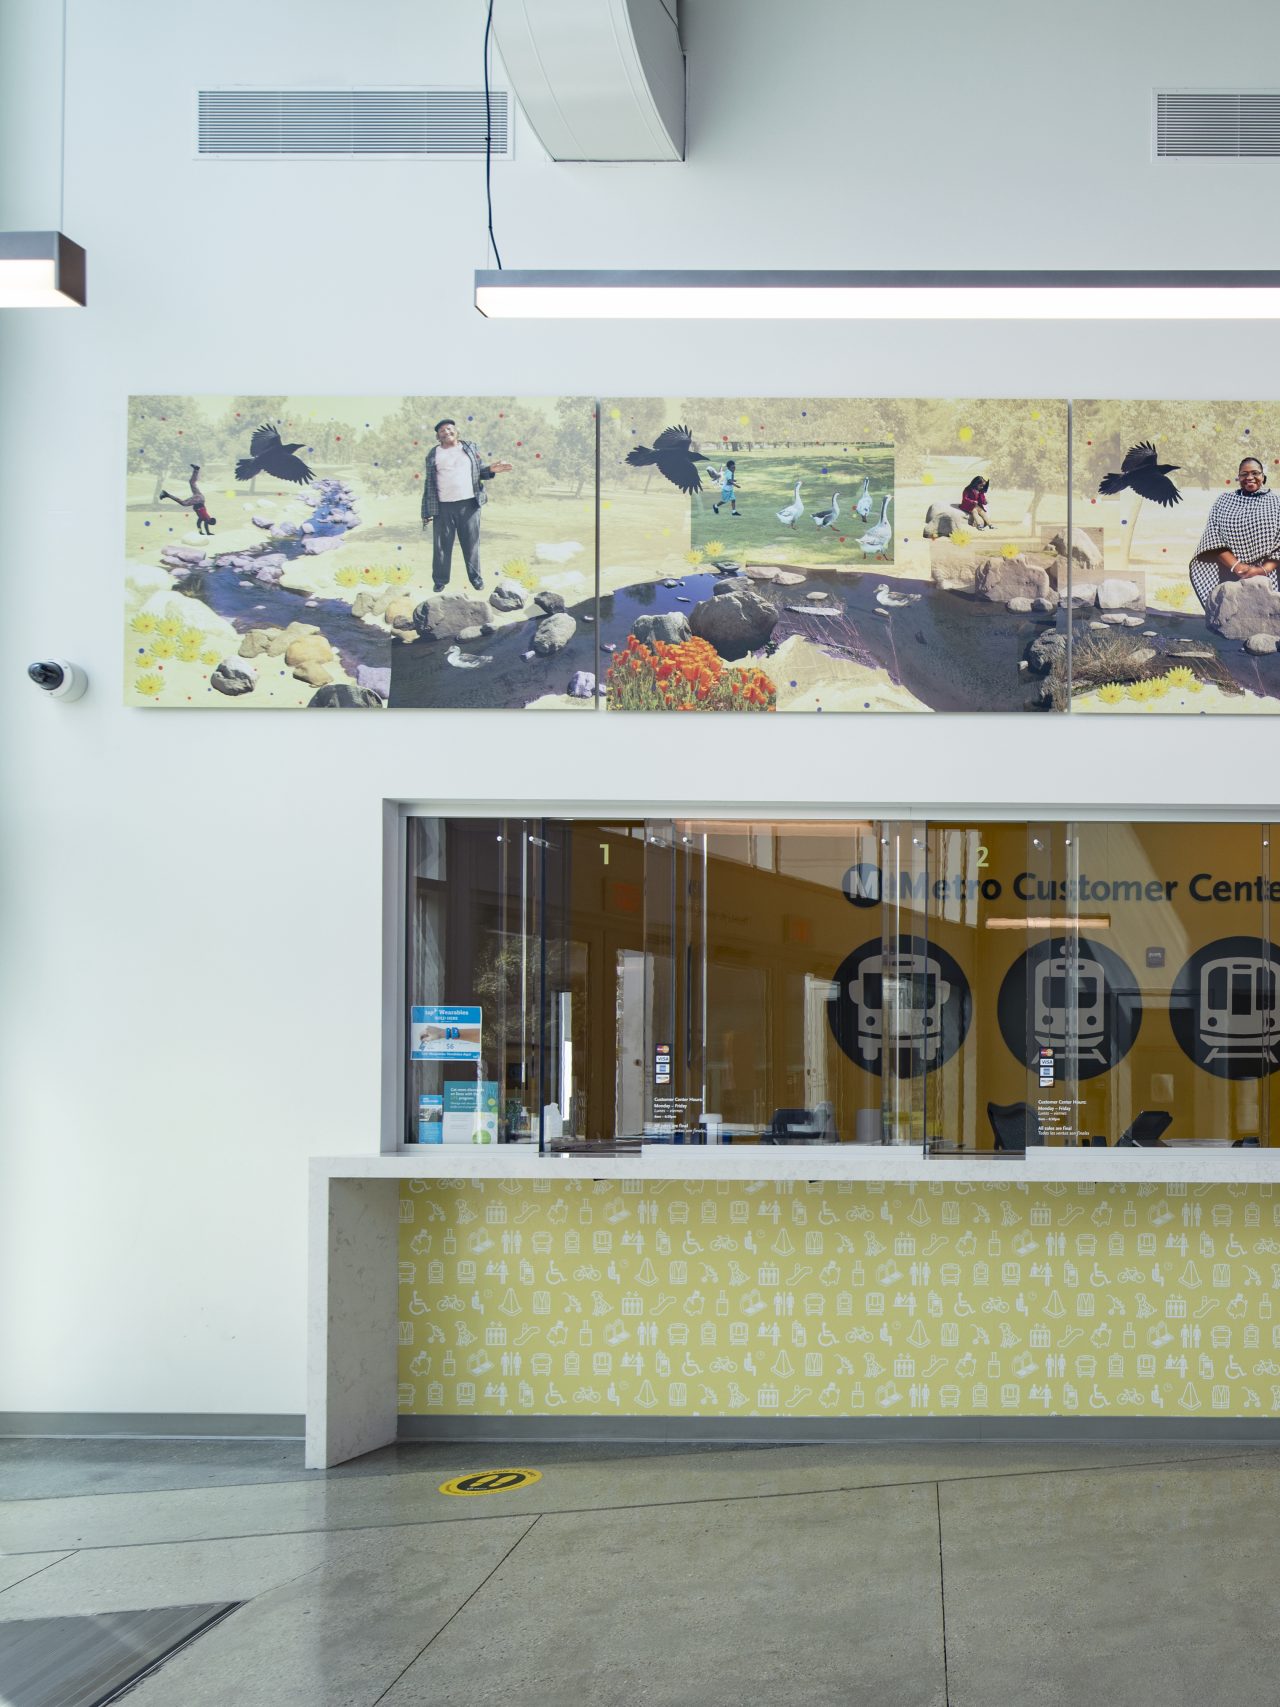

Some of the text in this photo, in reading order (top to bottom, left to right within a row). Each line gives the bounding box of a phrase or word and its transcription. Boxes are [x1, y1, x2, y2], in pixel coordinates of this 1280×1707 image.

[600, 844, 609, 865] 1
[976, 846, 989, 867] 2
[898, 871, 1002, 901] Metro
[1013, 872, 1178, 902] Customer
